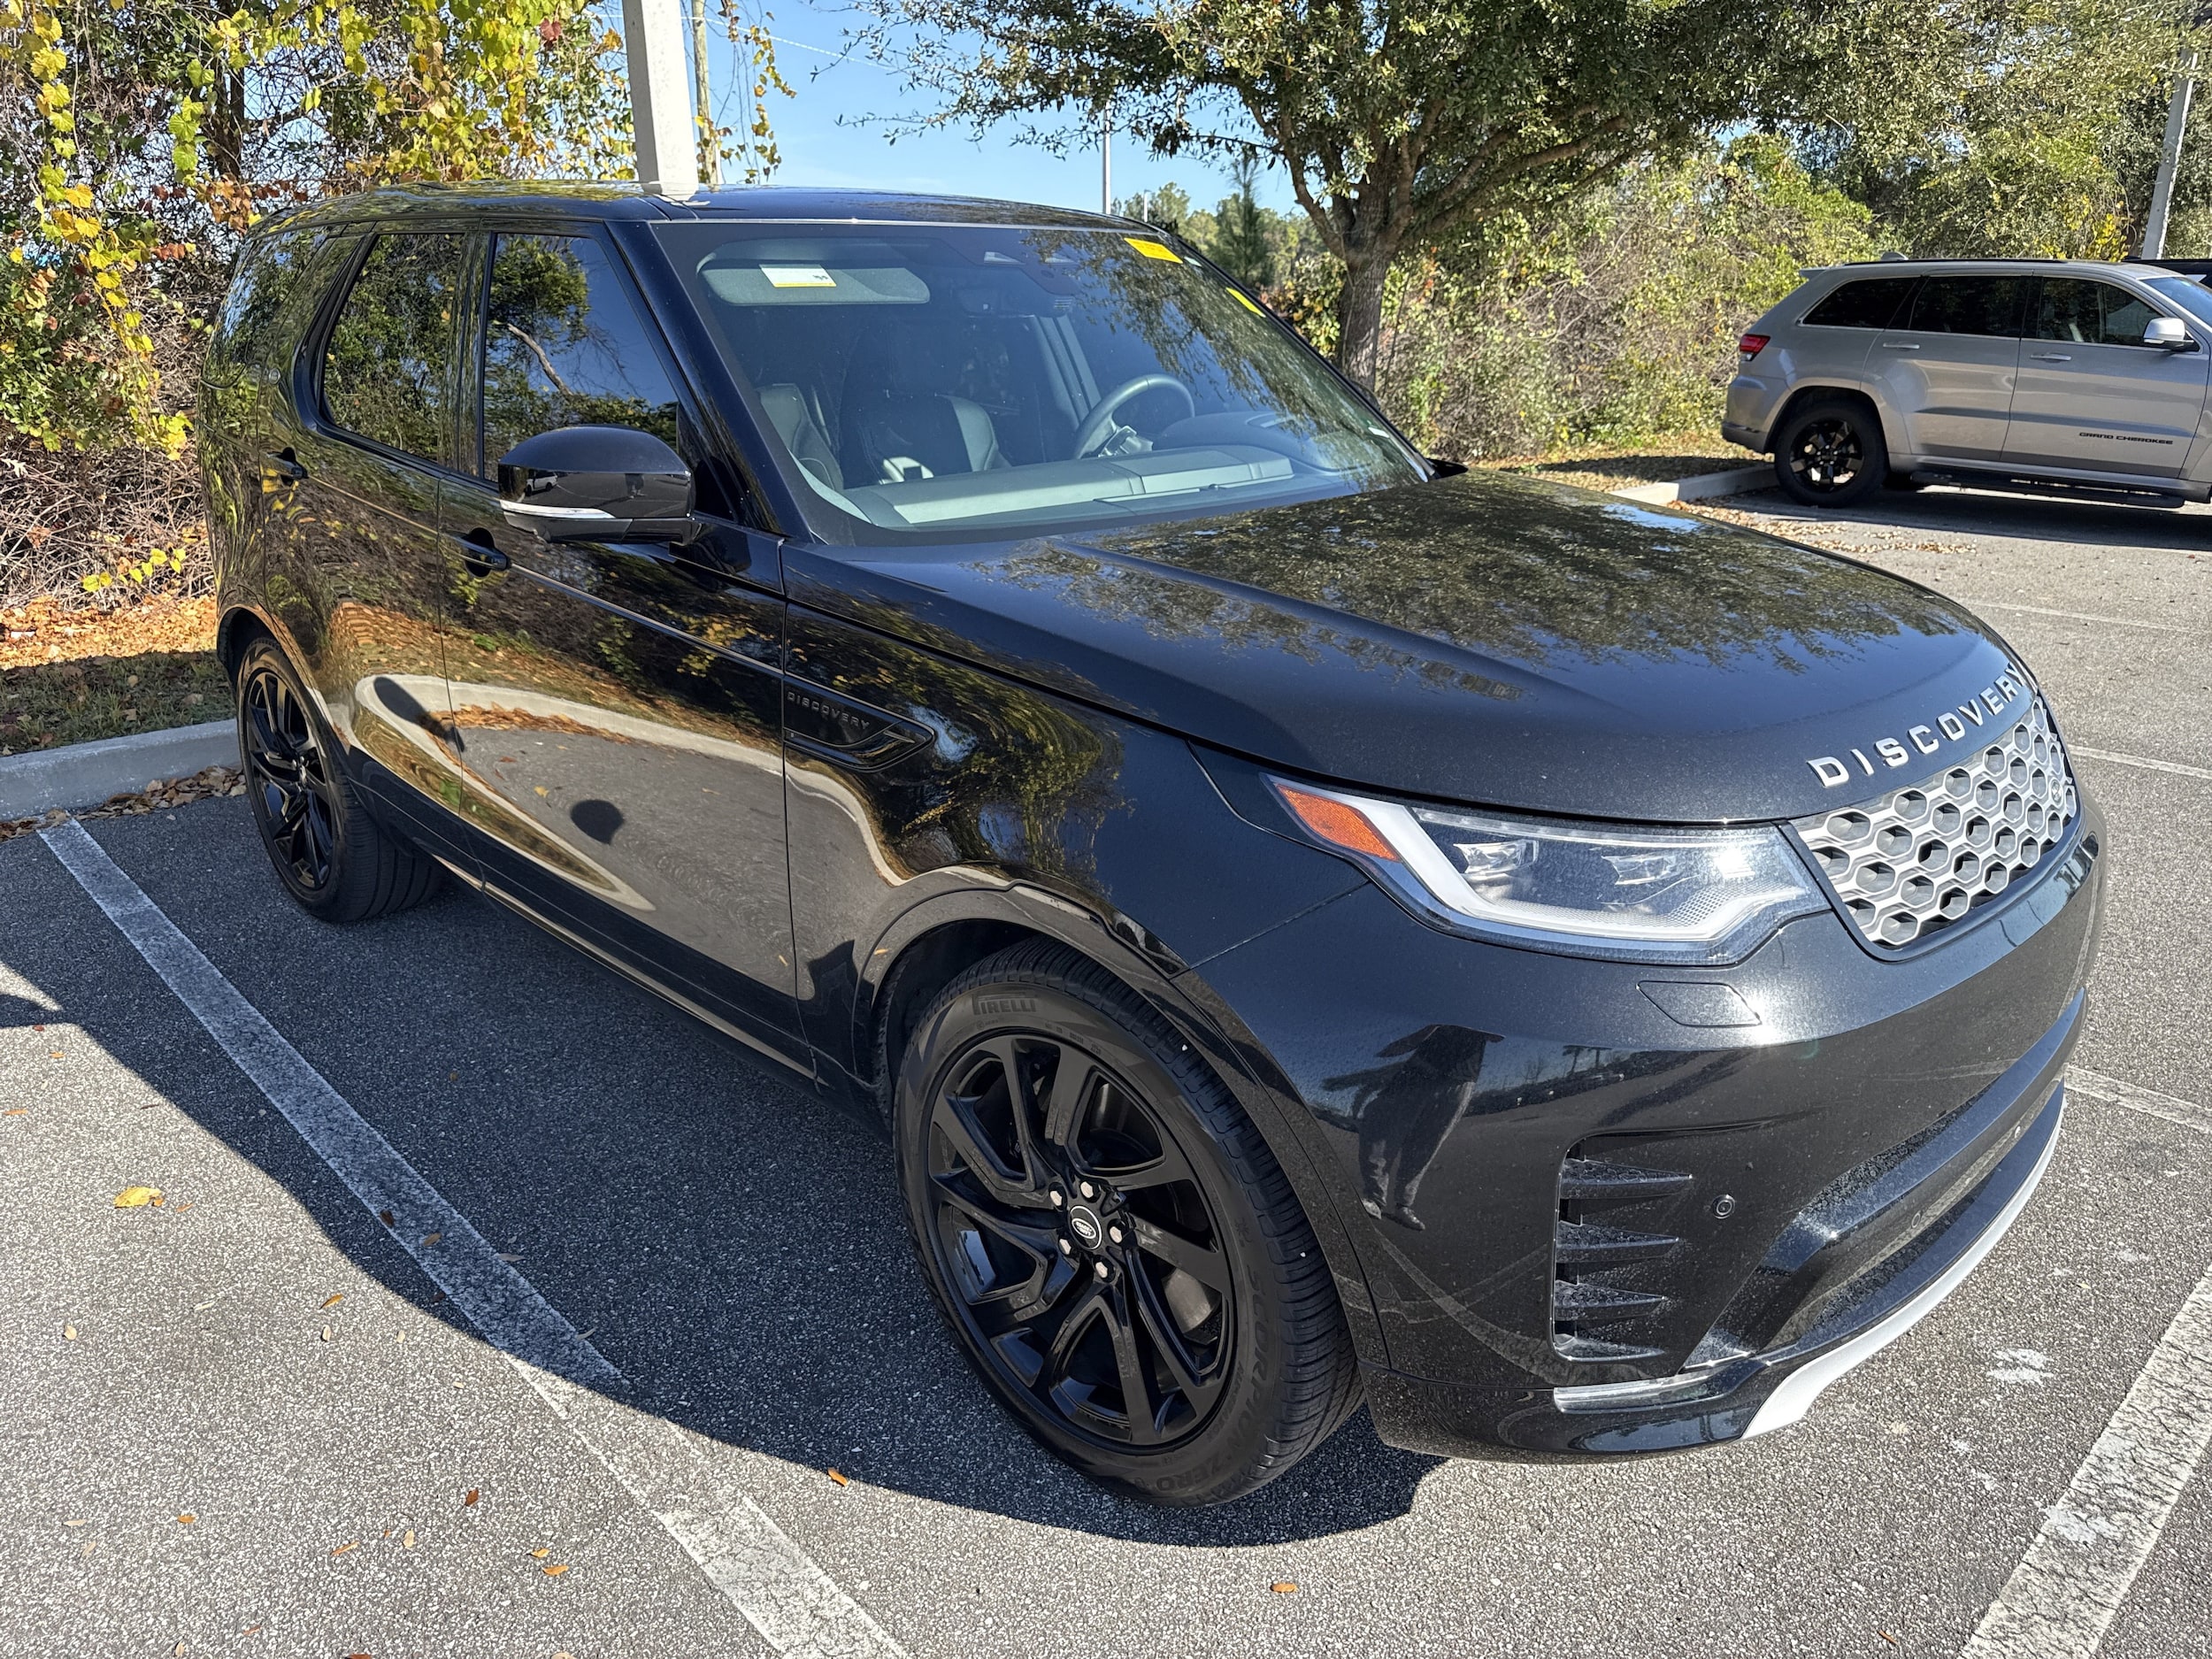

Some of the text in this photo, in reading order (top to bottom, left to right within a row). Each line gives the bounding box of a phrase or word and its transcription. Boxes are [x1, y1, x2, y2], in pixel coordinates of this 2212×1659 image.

[2079, 431, 2173, 445] GRAND CHEROKEE
[787, 691, 870, 730] DISCOVERY
[1805, 662, 2026, 788] DISCOVERY
[972, 992, 1037, 1016] PIRELLI
